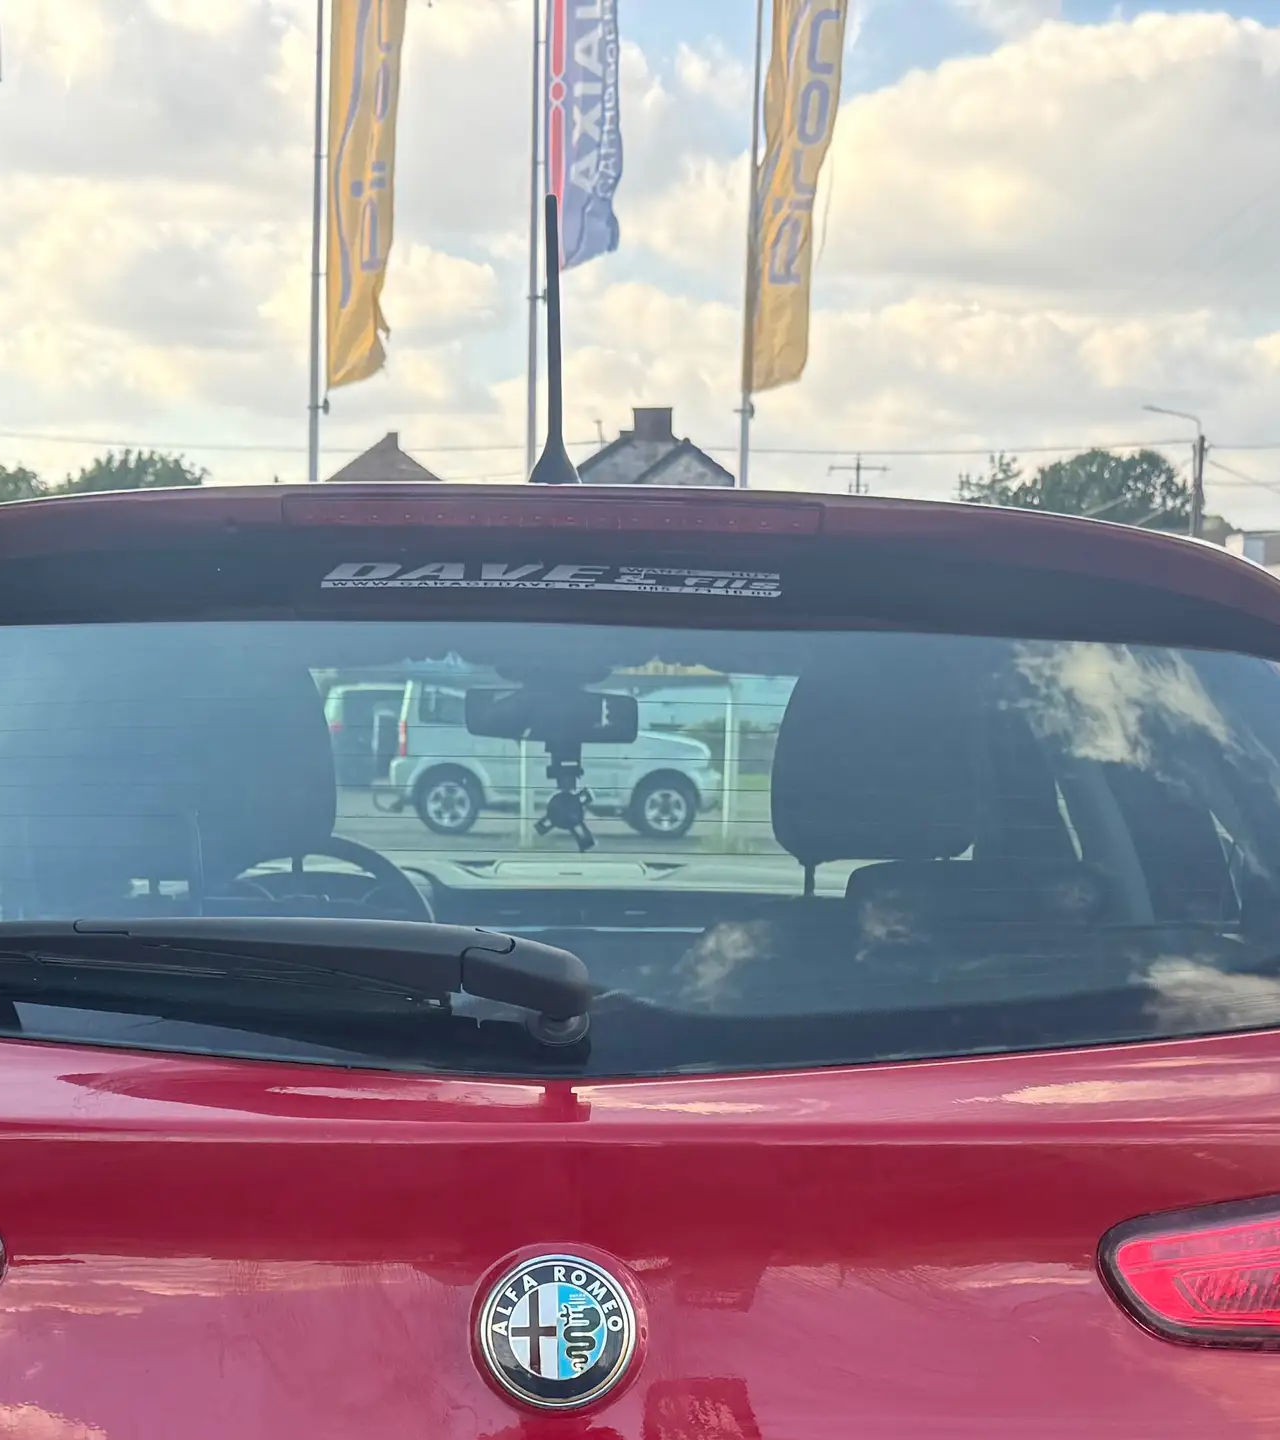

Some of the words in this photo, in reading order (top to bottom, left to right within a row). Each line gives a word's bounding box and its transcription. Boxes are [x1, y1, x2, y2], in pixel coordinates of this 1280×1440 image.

[322, 561, 610, 581] DAVE
[492, 1274, 538, 1336] ALFA
[553, 1266, 623, 1332] ROMEO
